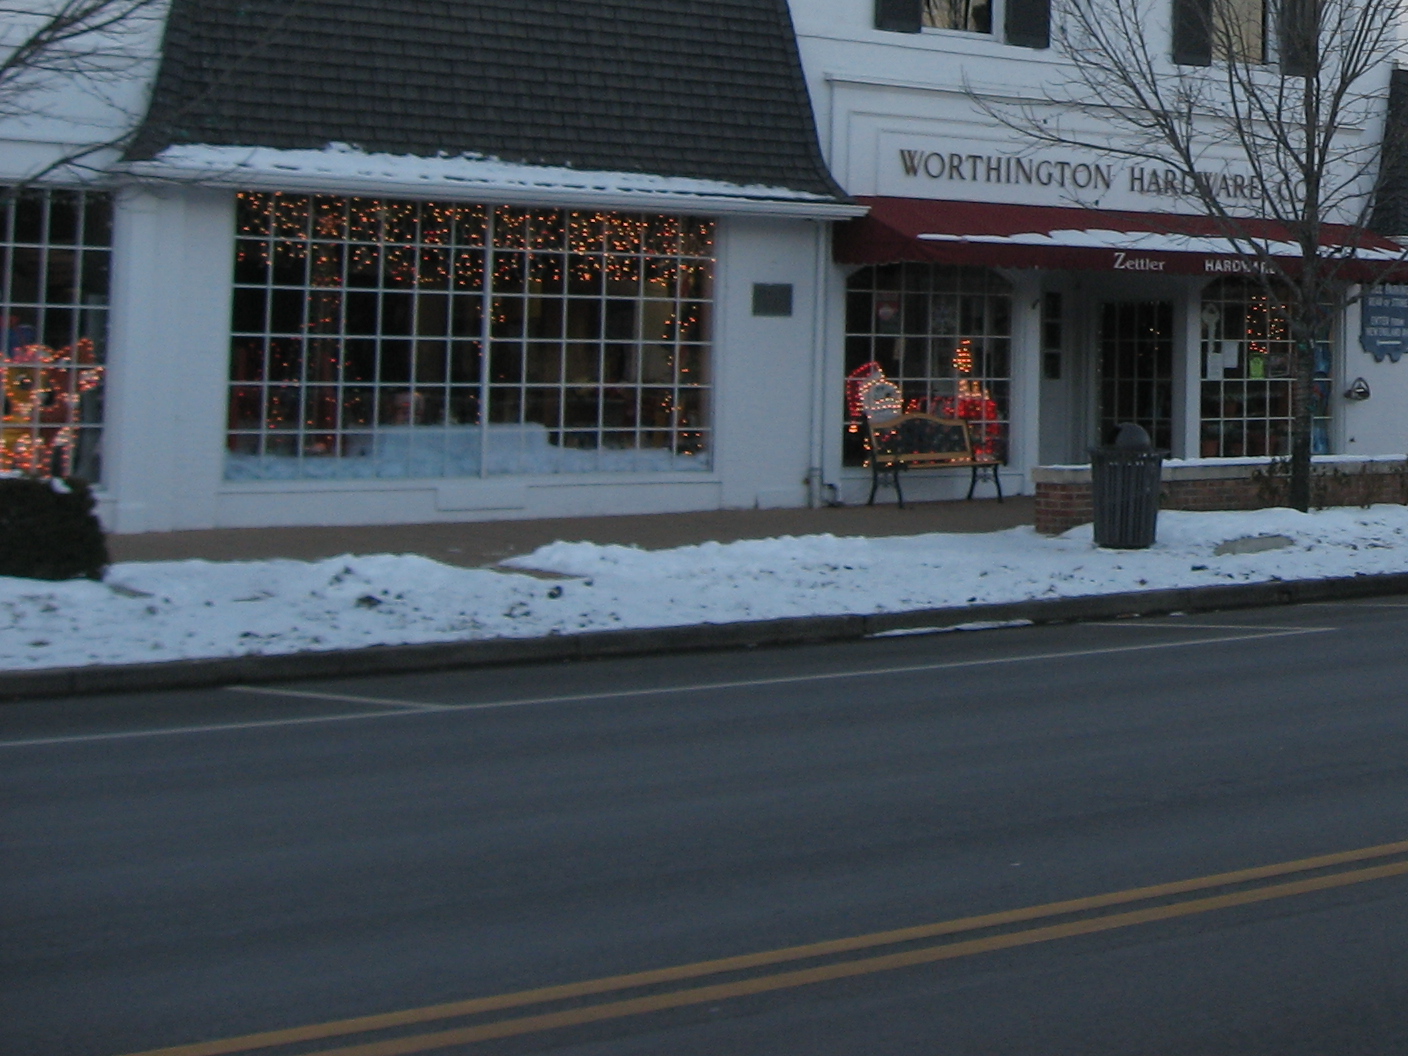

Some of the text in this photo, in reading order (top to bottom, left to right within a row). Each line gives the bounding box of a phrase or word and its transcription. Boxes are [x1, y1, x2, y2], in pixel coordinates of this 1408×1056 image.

[899, 149, 1113, 190] WORTHINGTON
[1130, 167, 1263, 201] HARDWARE
[1113, 252, 1166, 272] Zettler
